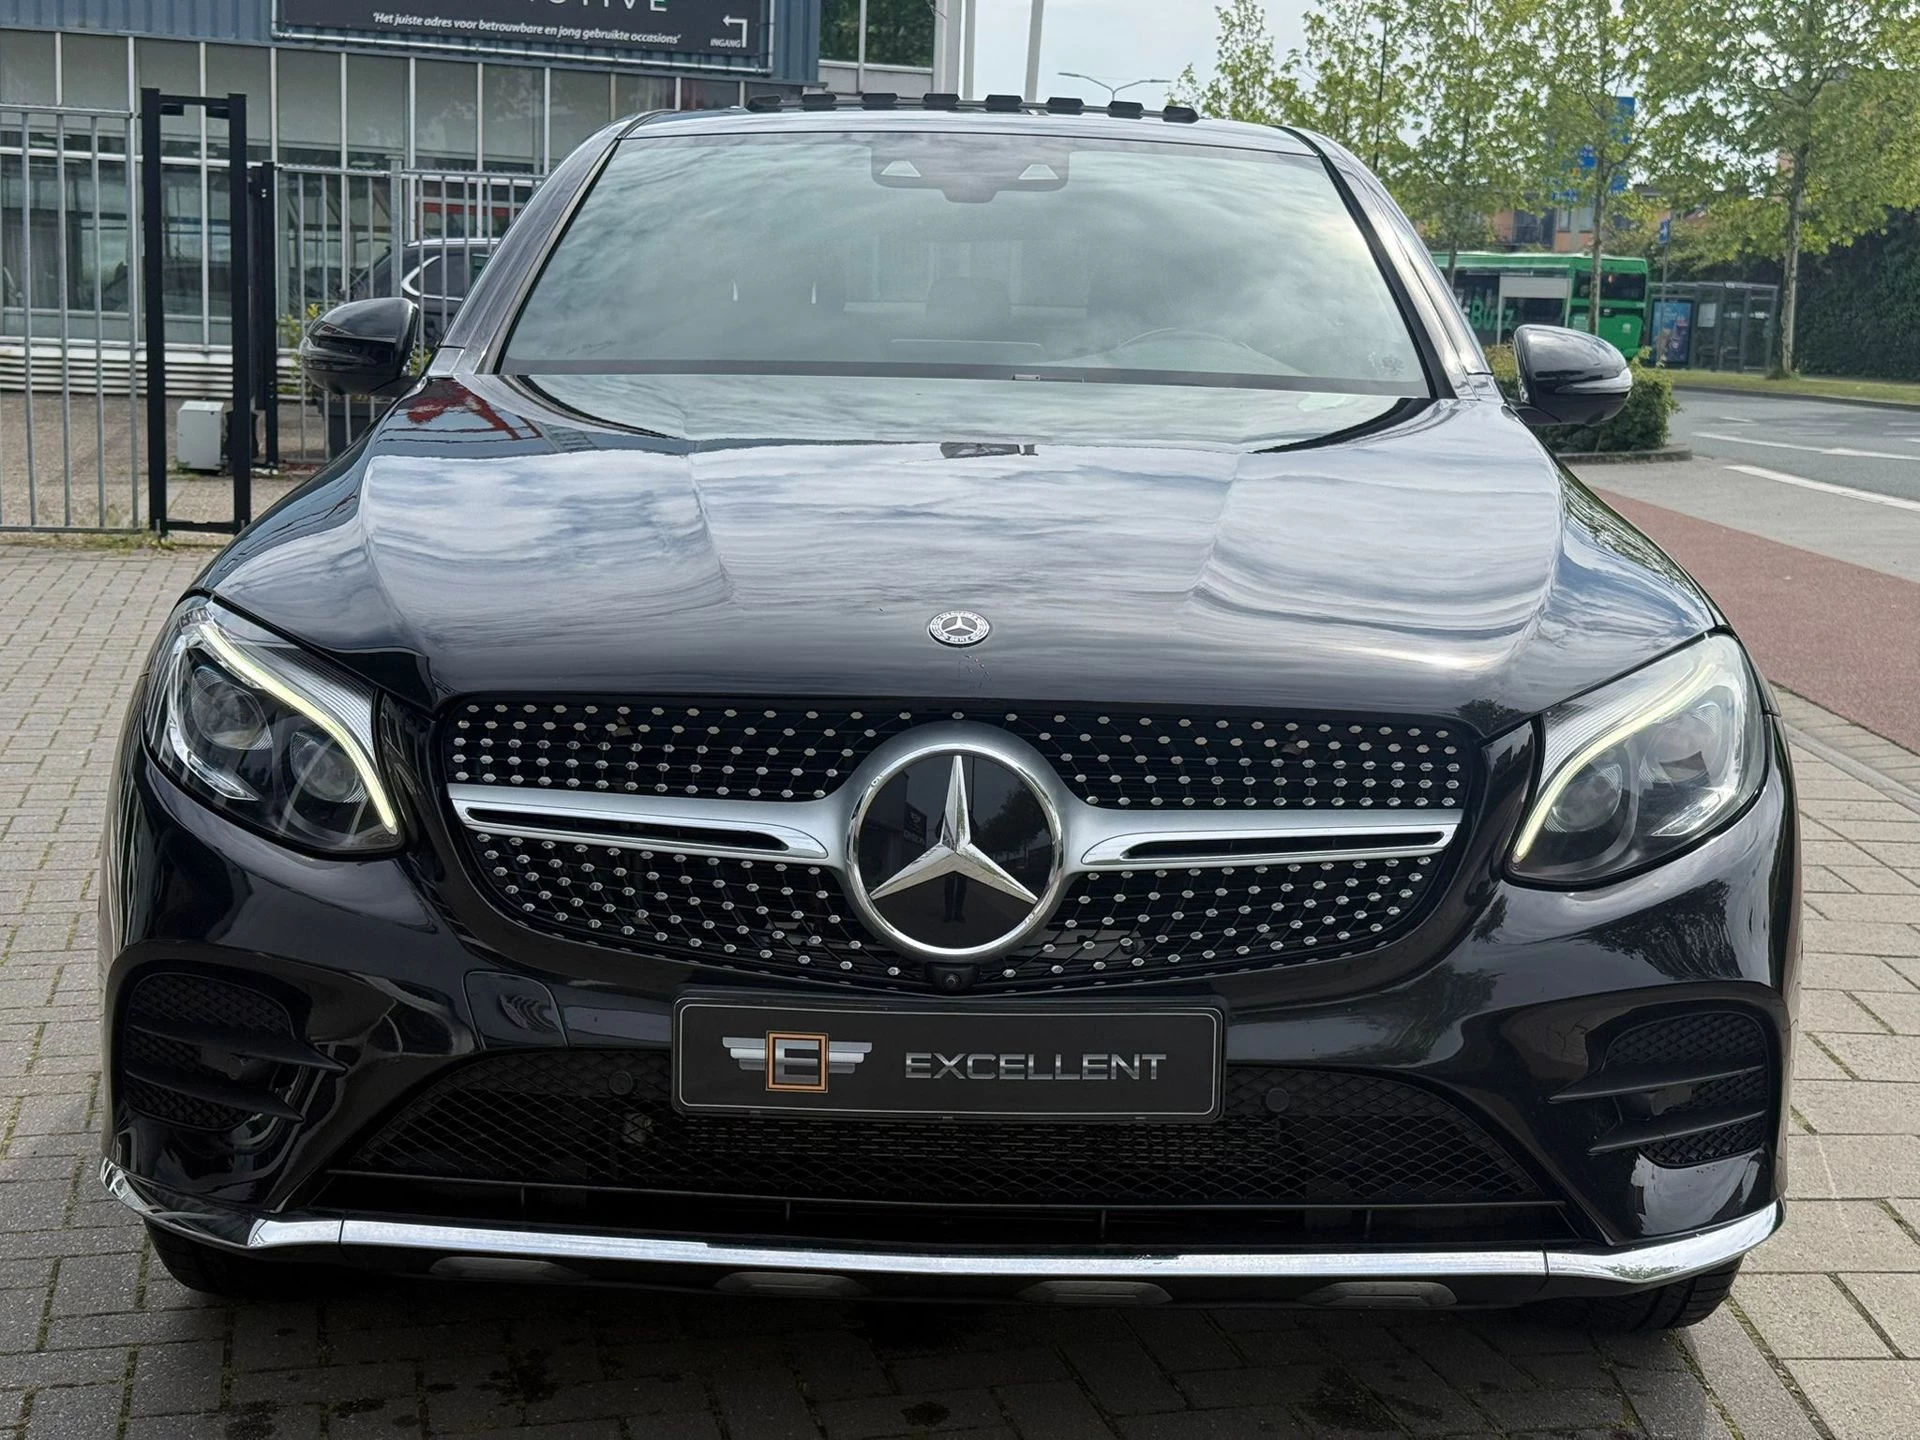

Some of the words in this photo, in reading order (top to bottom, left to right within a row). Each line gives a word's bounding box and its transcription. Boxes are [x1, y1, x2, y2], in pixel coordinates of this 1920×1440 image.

[393, 13, 423, 26] juiste
[423, 16, 453, 28] adres
[453, 20, 478, 29] voor
[478, 19, 544, 35] betrouwbare
[544, 26, 557, 35] en
[557, 26, 581, 39] jong
[582, 28, 630, 41] gebruikte
[710, 38, 741, 48] INGANG
[904, 1051, 1167, 1081] EXCELLENT
